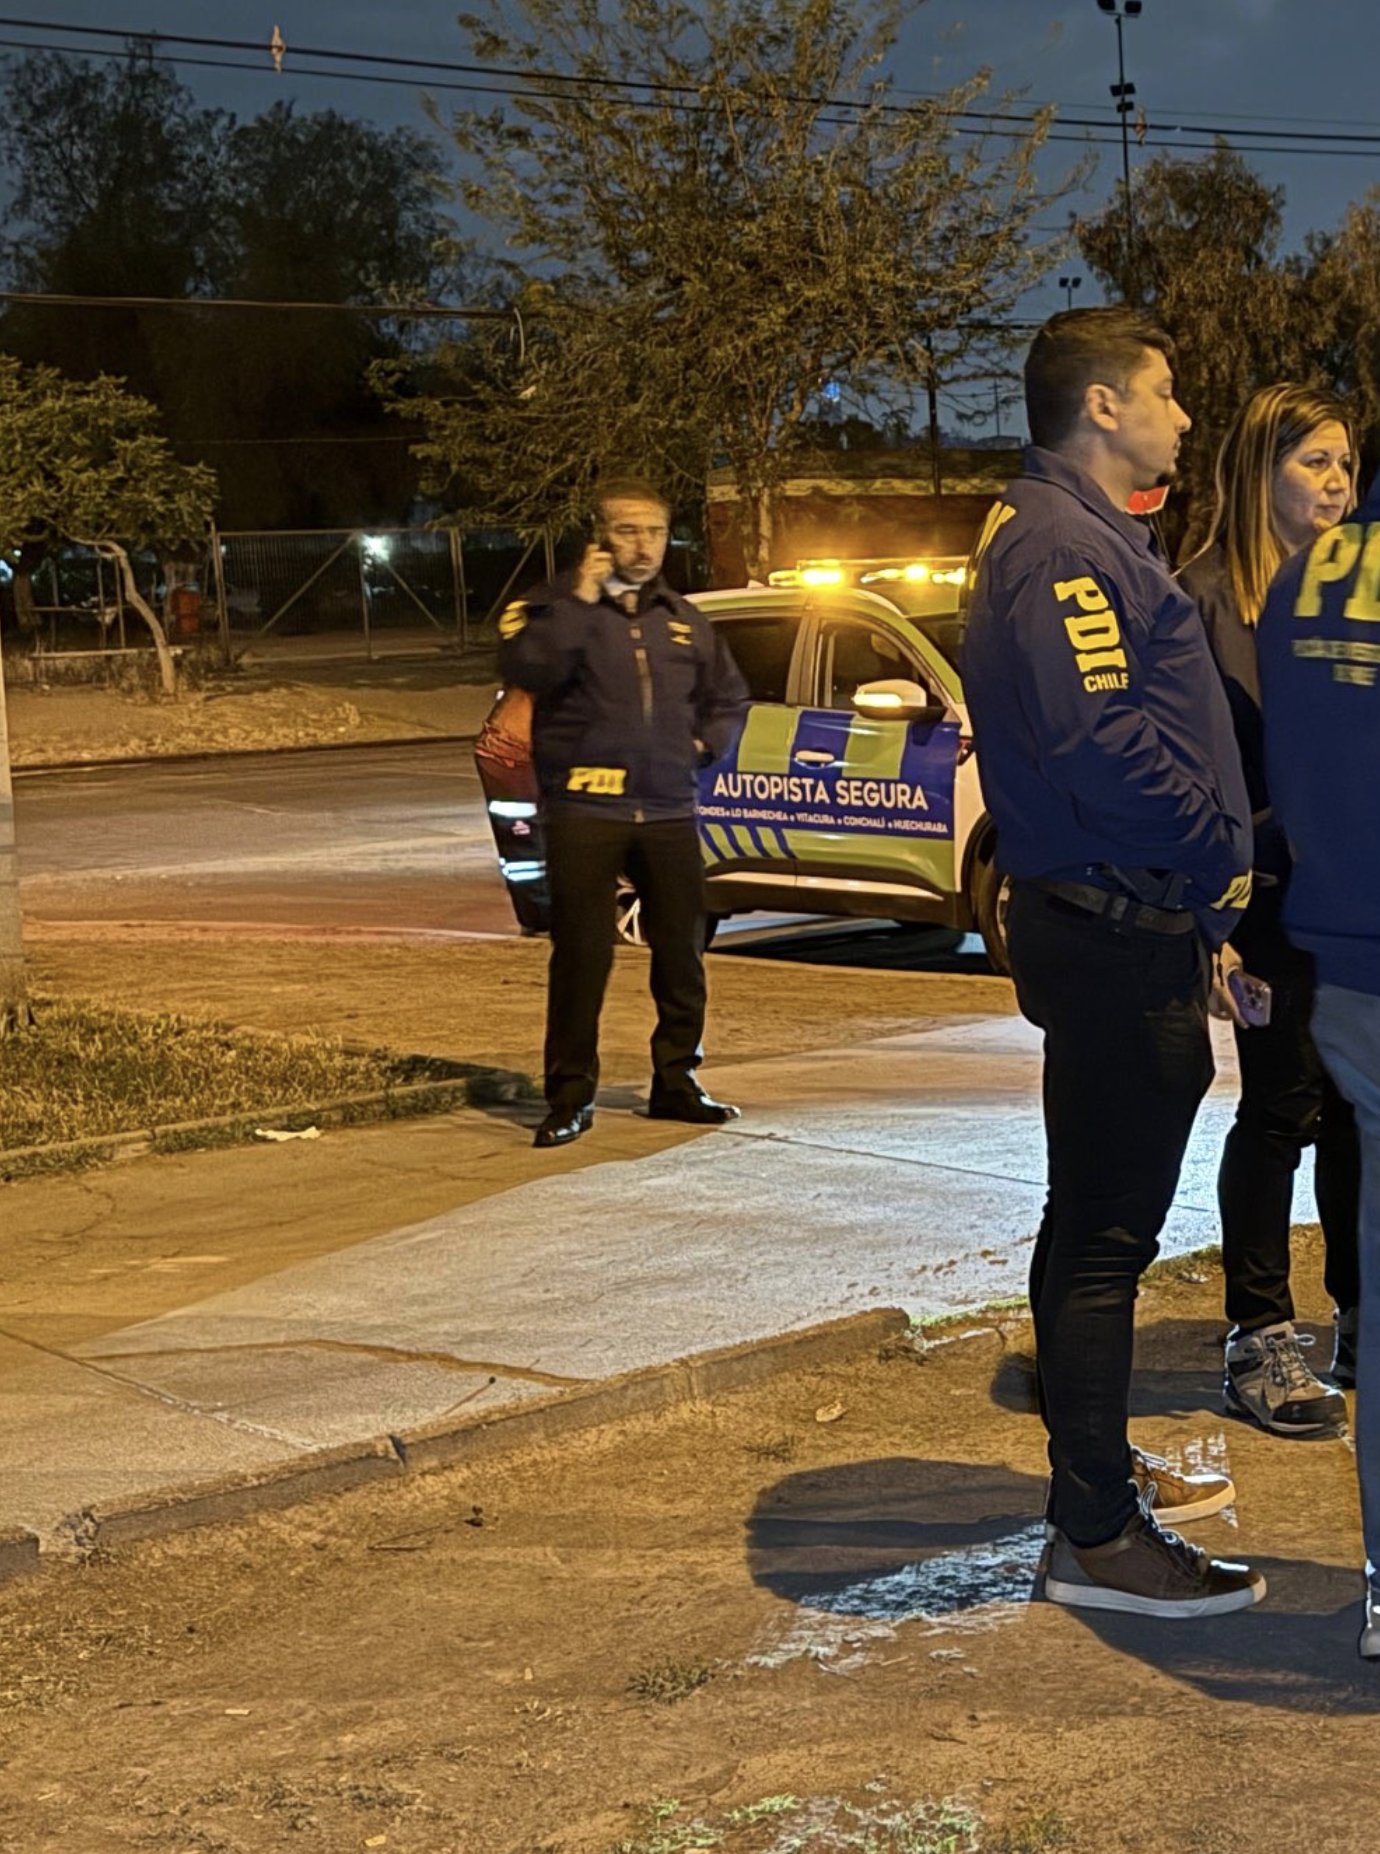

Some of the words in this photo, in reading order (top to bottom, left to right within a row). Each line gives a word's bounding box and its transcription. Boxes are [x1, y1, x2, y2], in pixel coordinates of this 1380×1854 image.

[1053, 576, 1127, 672] PDI
[1083, 672, 1129, 693] CHILE
[566, 766, 626, 795] PDI
[713, 773, 830, 804] AUTOPISTA
[835, 780, 929, 810] SEGURA
[697, 805, 725, 817] ONDES
[796, 812, 836, 825] VITACURA
[893, 818, 949, 834] HUECHURABA
[1208, 868, 1253, 911] PD
